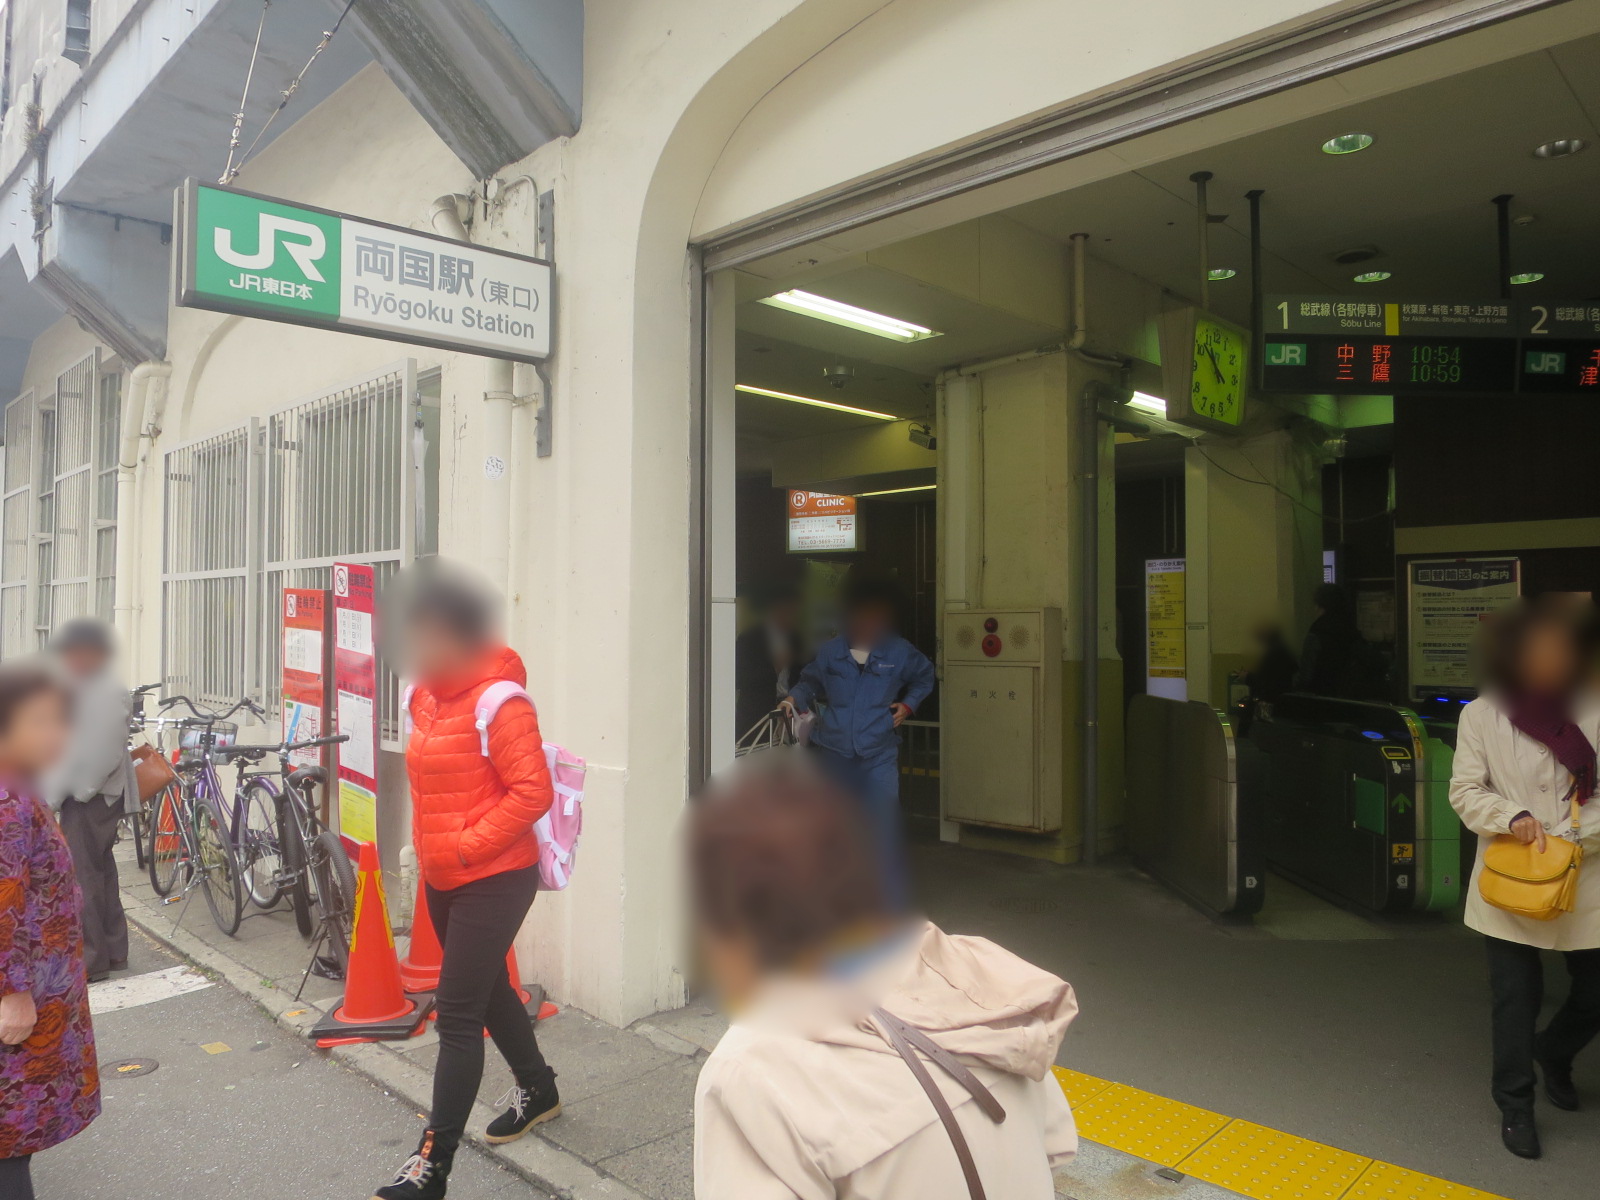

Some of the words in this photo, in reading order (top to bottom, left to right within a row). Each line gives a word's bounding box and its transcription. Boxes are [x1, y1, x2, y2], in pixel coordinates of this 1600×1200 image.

[213, 212, 326, 283] JR
[229, 273, 313, 300] JR東日本
[354, 286, 453, 324] Ryōgoku
[462, 306, 534, 339] Station
[1277, 301, 1288, 329] 1
[1364, 319, 1382, 328] Line
[1531, 306, 1549, 334] 2
[1205, 334, 1212, 346] 11
[1213, 331, 1220, 344] 12
[1197, 343, 1204, 356] 10
[1223, 340, 1227, 351] 1
[1229, 354, 1235, 365] 2
[1271, 345, 1300, 363] JR
[1411, 346, 1461, 363] 10:54
[1192, 360, 1197, 371] 9
[1531, 353, 1560, 372] JR
[1410, 364, 1461, 382] 10:59
[1231, 375, 1237, 386] 3
[1194, 381, 1200, 393] 8
[1202, 397, 1207, 408] 7
[1227, 393, 1232, 404] 4
[1210, 403, 1215, 414] 6
[1218, 402, 1223, 413] 5
[816, 498, 844, 507] CLINIC
